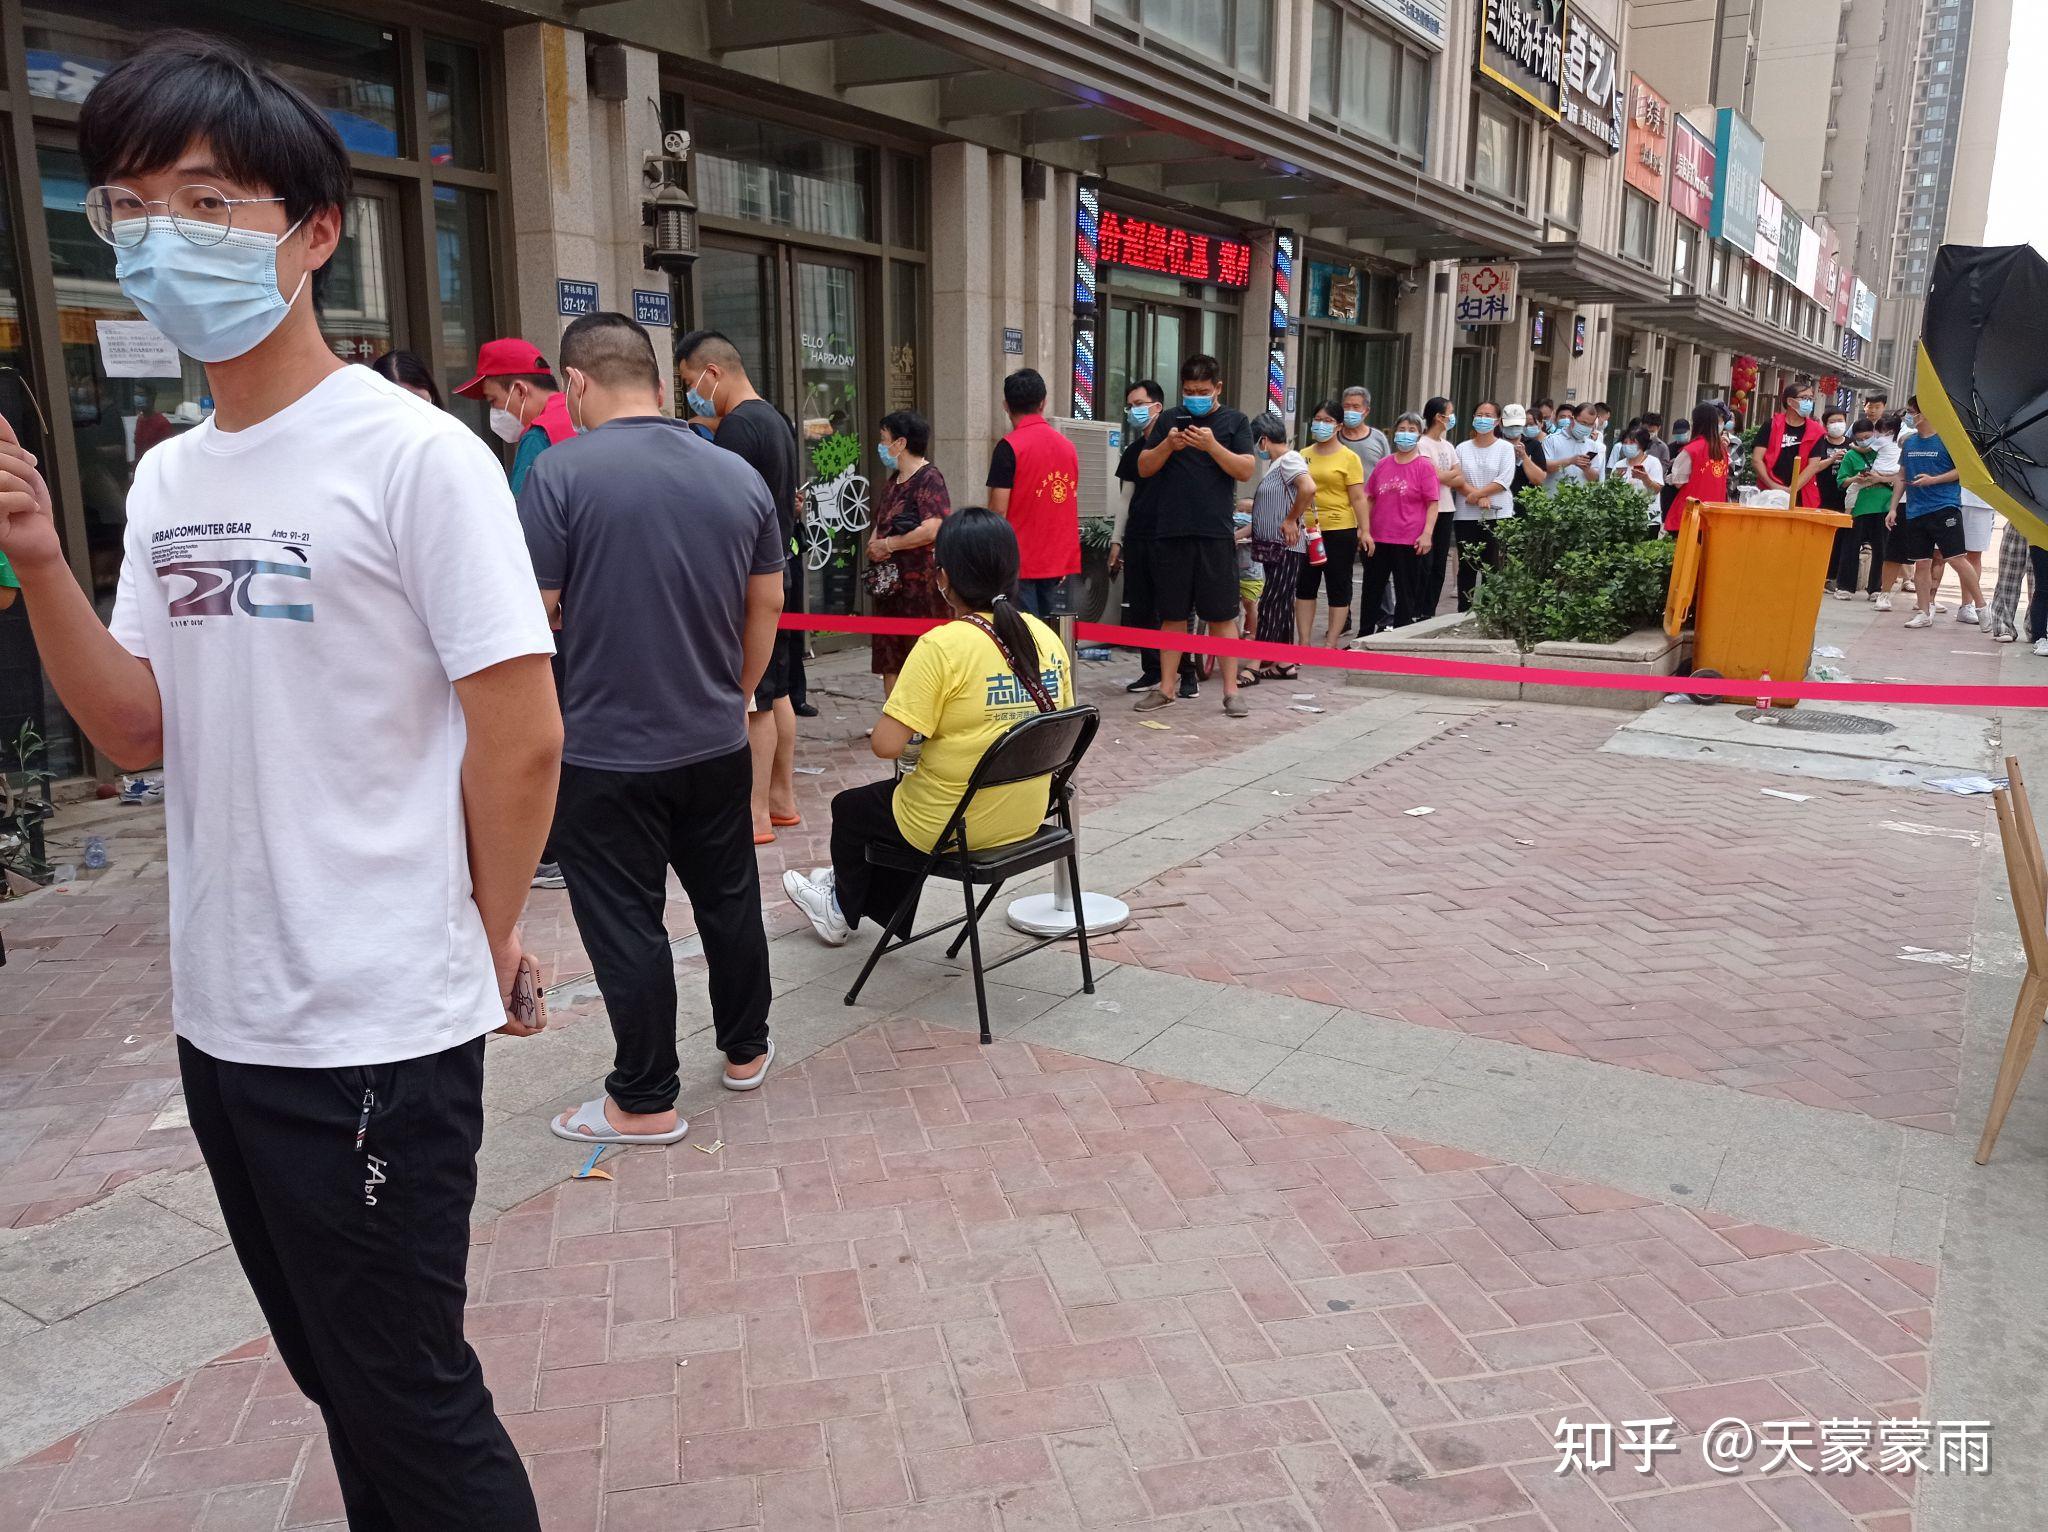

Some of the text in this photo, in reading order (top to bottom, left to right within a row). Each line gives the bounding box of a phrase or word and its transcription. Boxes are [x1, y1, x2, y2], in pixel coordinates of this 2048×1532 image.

[563, 297, 586, 312] 37-12
[1457, 294, 1509, 320] 妇科
[638, 307, 659, 321] 37-13
[811, 350, 856, 367] HAPPY DAY
[174, 523, 224, 538] COMMUTER
[226, 522, 252, 534] GEAR
[290, 532, 310, 542] 91-21
